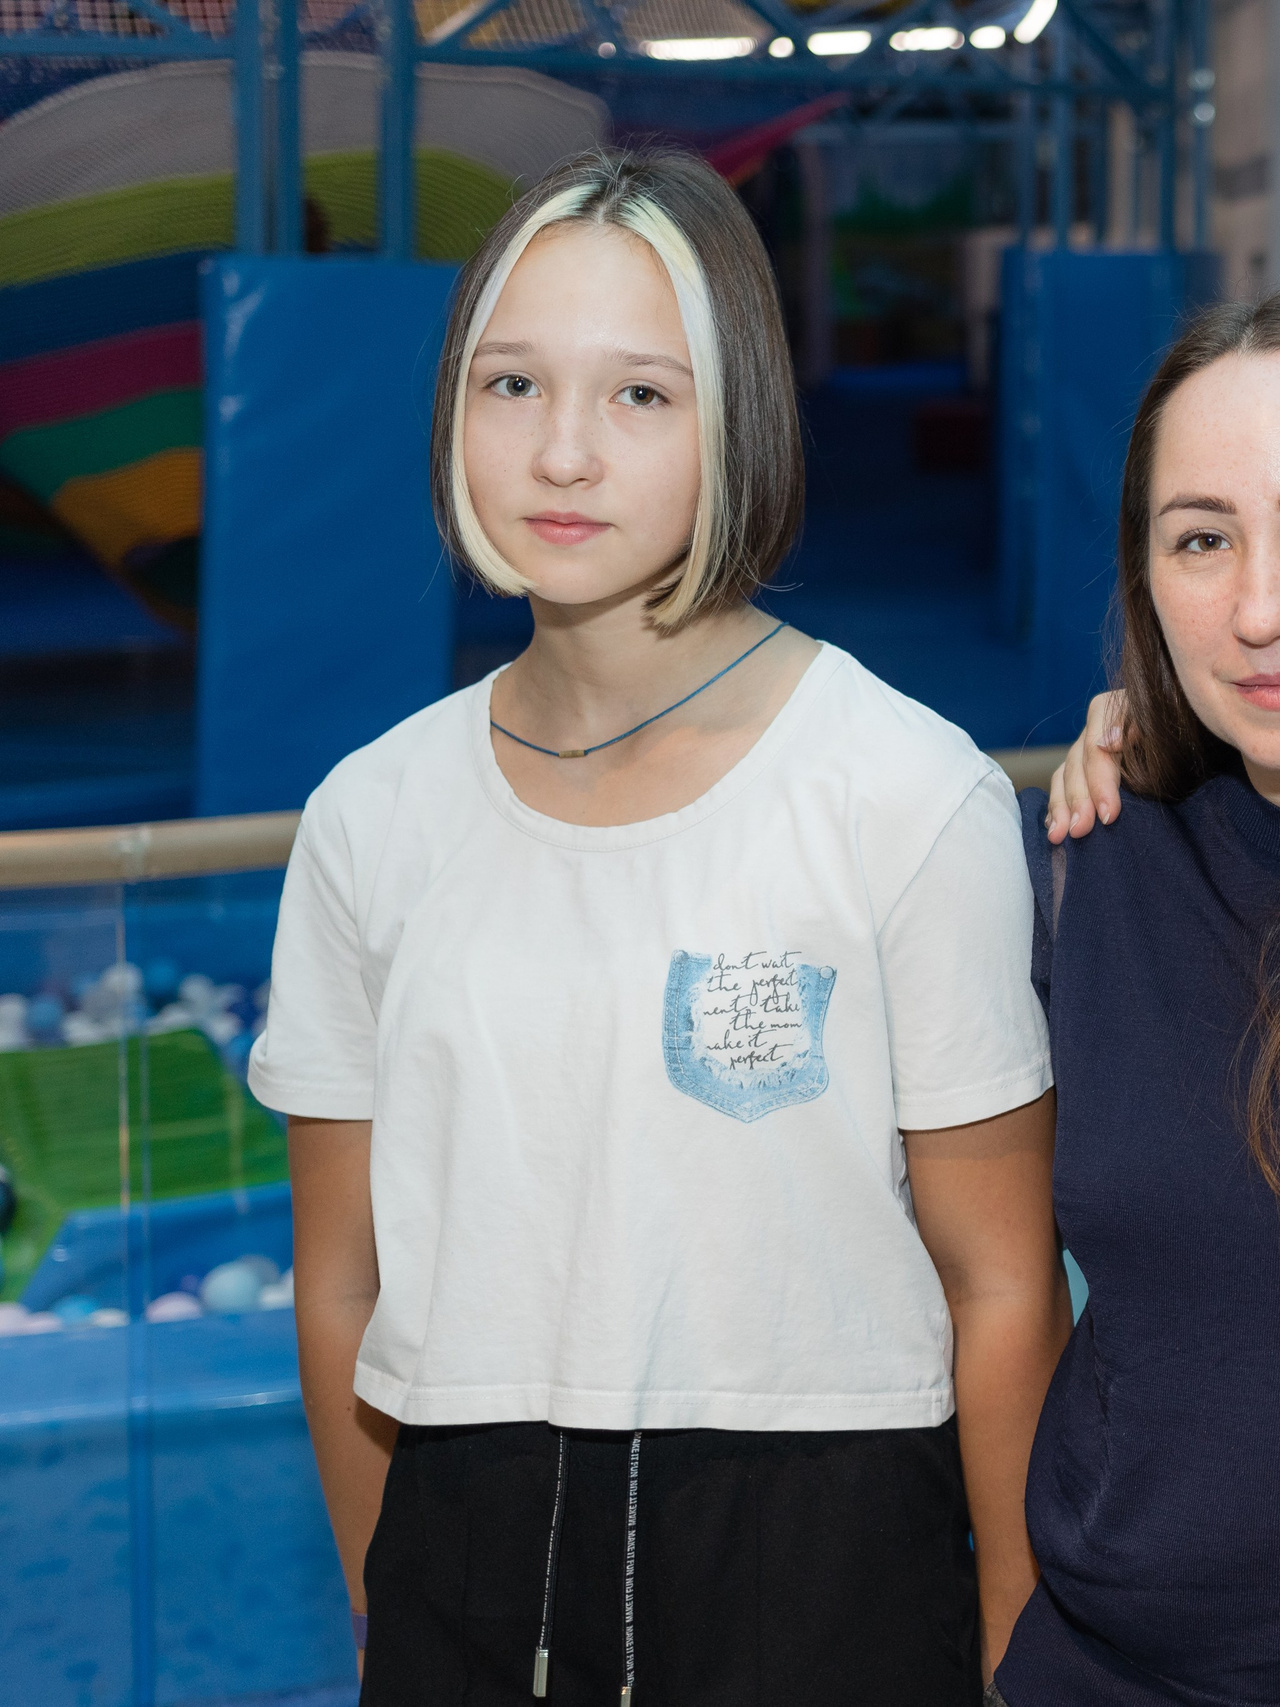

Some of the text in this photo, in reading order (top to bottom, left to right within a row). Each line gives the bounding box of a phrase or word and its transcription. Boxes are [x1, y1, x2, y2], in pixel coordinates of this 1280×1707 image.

[761, 951, 802, 969] wait
[749, 968, 798, 1006] perfect
[760, 992, 800, 1013] take
[729, 1009, 766, 1031] the
[748, 1029, 777, 1048] it
[729, 1043, 793, 1070] perfect
[631, 1431, 642, 1453] MAKE
[630, 1461, 639, 1477] FUN
[629, 1480, 638, 1496] FUN
[628, 1505, 637, 1526] MAKE
[627, 1530, 636, 1552] MAKE
[626, 1560, 635, 1576] FUN
[625, 1577, 634, 1593] FUN
[625, 1601, 634, 1623] MAKE
[625, 1625, 634, 1647] MAKE
[626, 1654, 635, 1670] FUN
